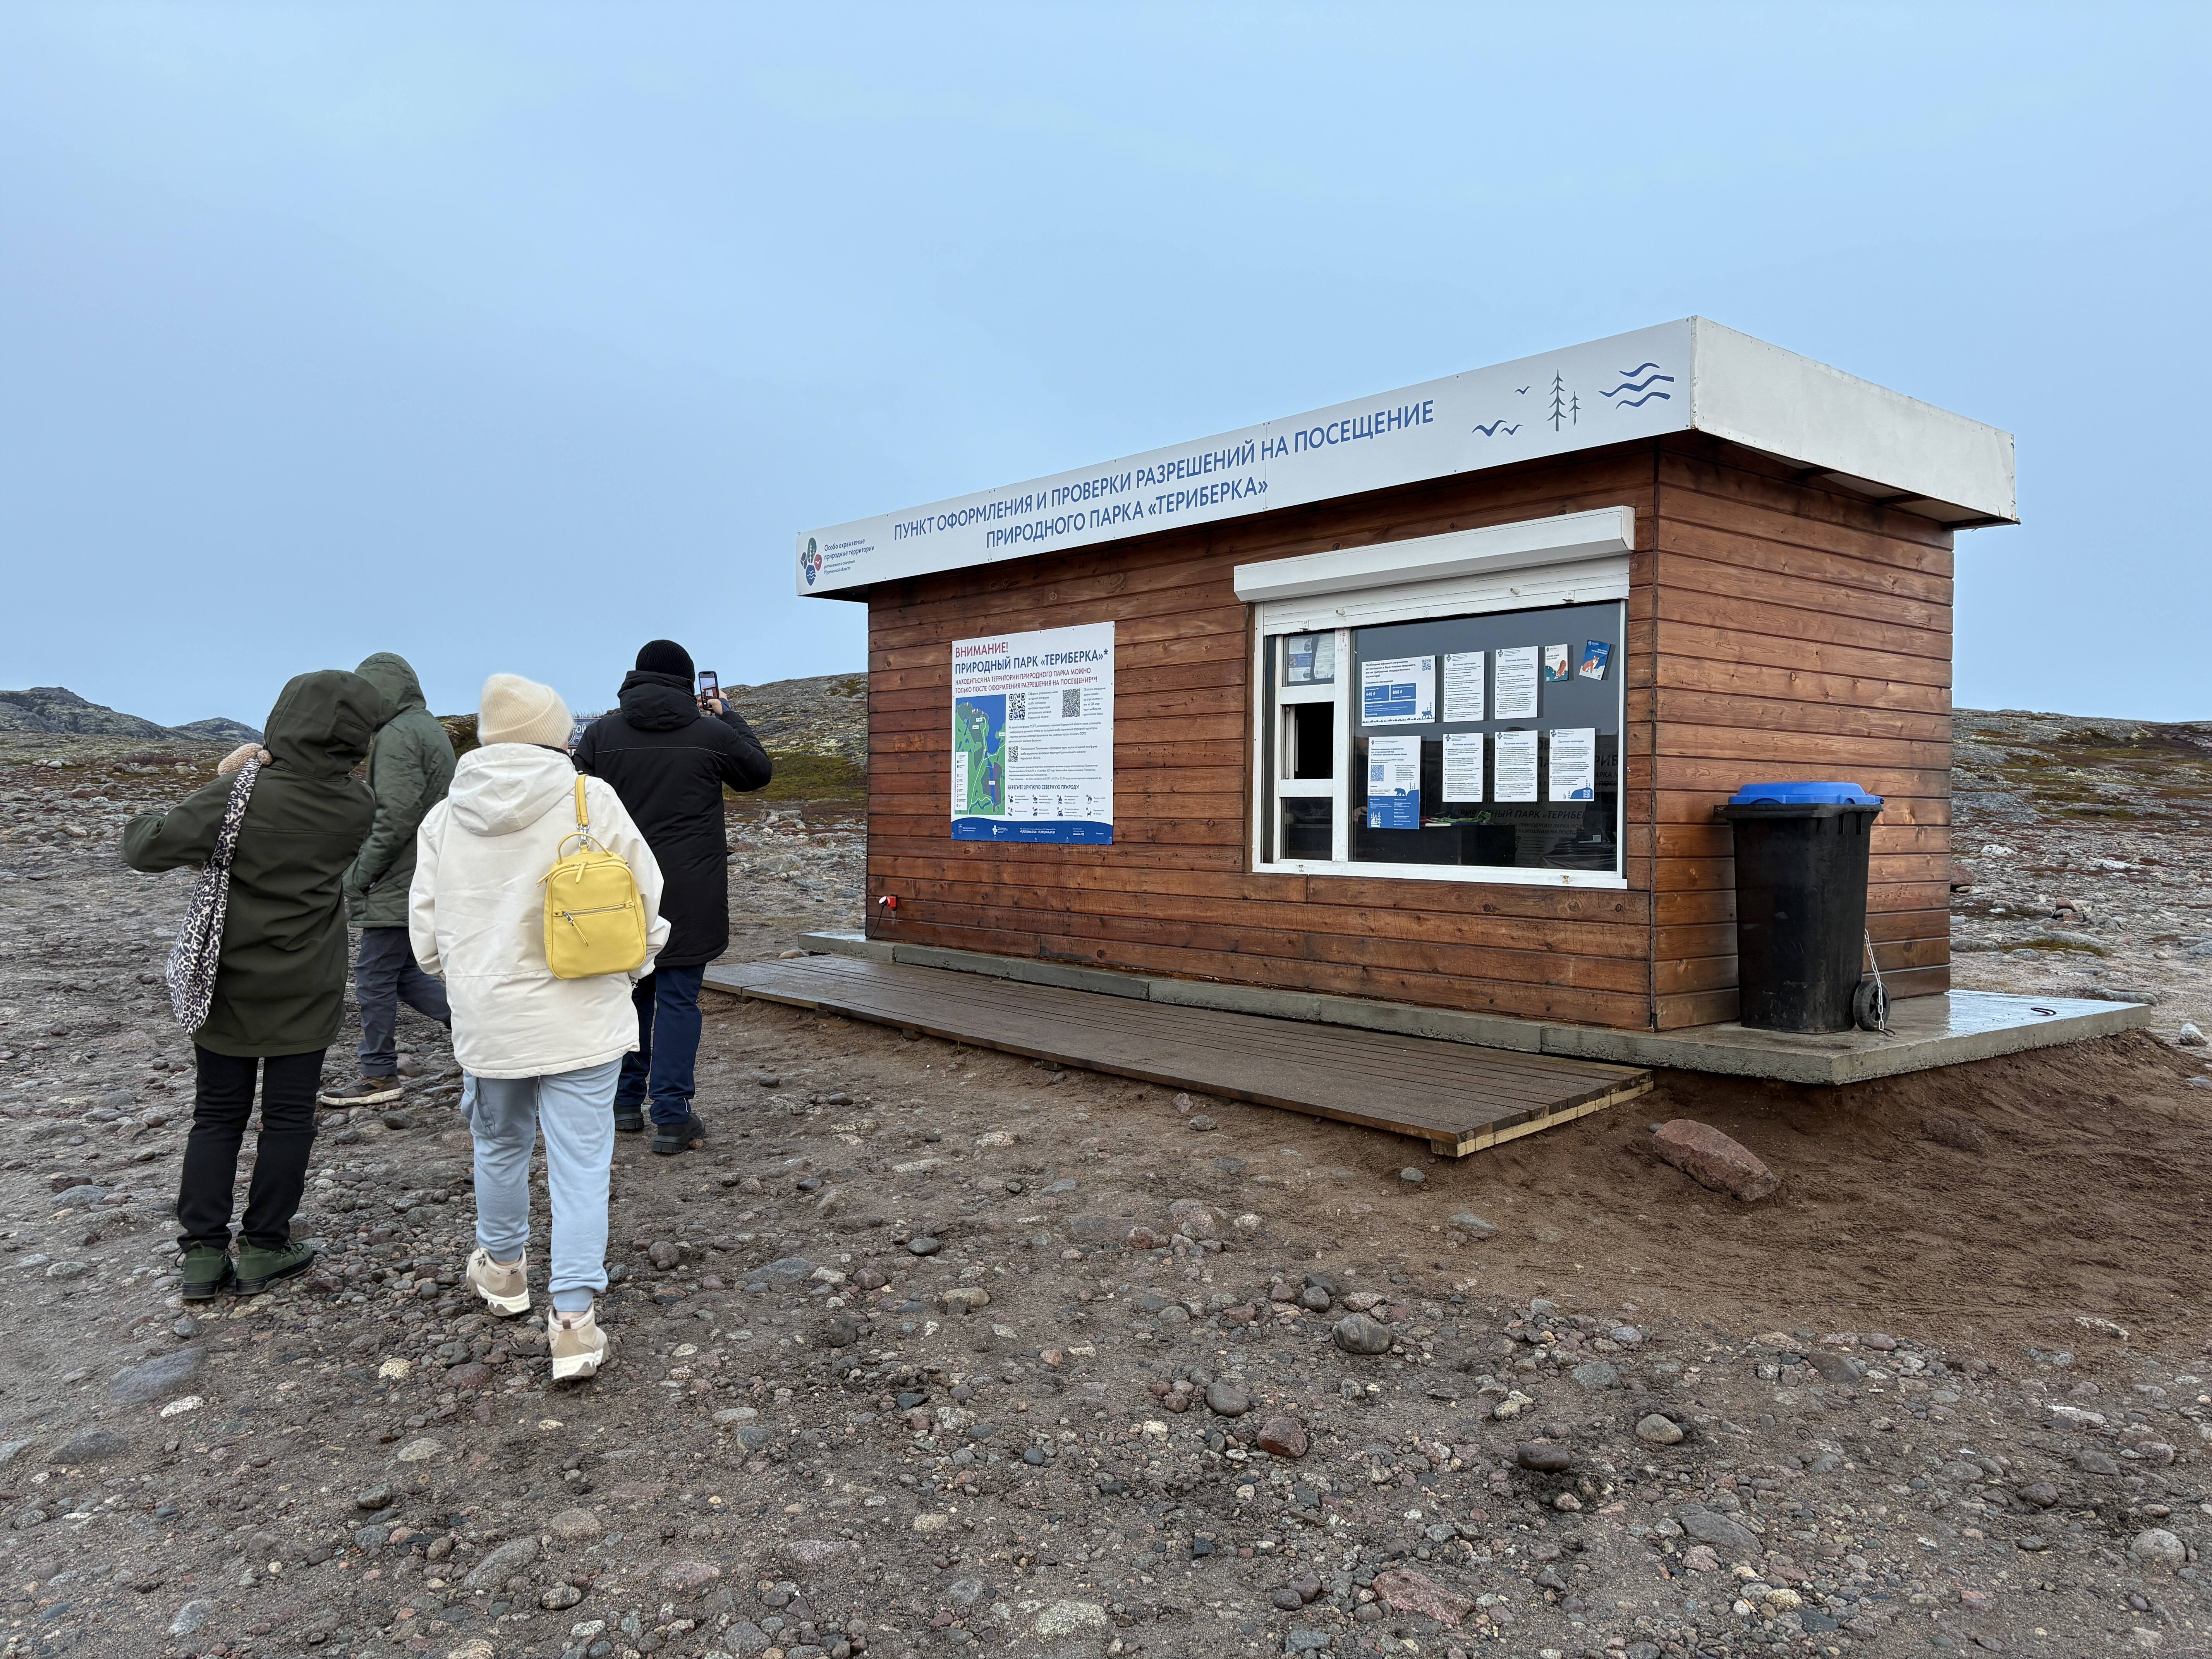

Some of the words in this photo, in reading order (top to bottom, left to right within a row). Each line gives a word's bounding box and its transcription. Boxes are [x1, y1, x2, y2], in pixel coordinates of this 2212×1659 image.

[894, 516, 934, 540] ПУНКТ
[937, 494, 1032, 531] ОФОРМЛЕНИЯ
[1037, 491, 1046, 510] И
[1051, 472, 1131, 507] ПРОВЕРКИ
[1136, 438, 1254, 488] РАЗРЕШЕНИЙ
[1261, 436, 1289, 460] НА
[1295, 400, 1433, 453] ПОСЕЩЕНИЕ
[986, 512, 1085, 548] ПРИРОДНОГО
[1090, 500, 1144, 528] ПАРКА
[1148, 476, 1268, 515] «ТЕРИБЕРКА»
[824, 543, 838, 551] Особо
[839, 539, 865, 549] охраняемые
[824, 551, 848, 561] природные
[849, 545, 875, 556] территории
[955, 641, 1008, 658] ВНИМАНИЕ!
[955, 656, 1011, 675] ПРИРОДНЫЙ
[1014, 655, 1038, 669] ПАРК
[955, 677, 983, 685] НАХОДИТЬСЯ
[991, 674, 1019, 682] ТЕРРИТОРИИ
[1020, 671, 1052, 680] ПРИРОДНОГО
[988, 683, 1020, 691] ОФОРМЛЕНИЯ
[1021, 680, 1051, 689] РАЗРЕШЕНИЯ
[1515, 810, 1540, 818] ПАРК
